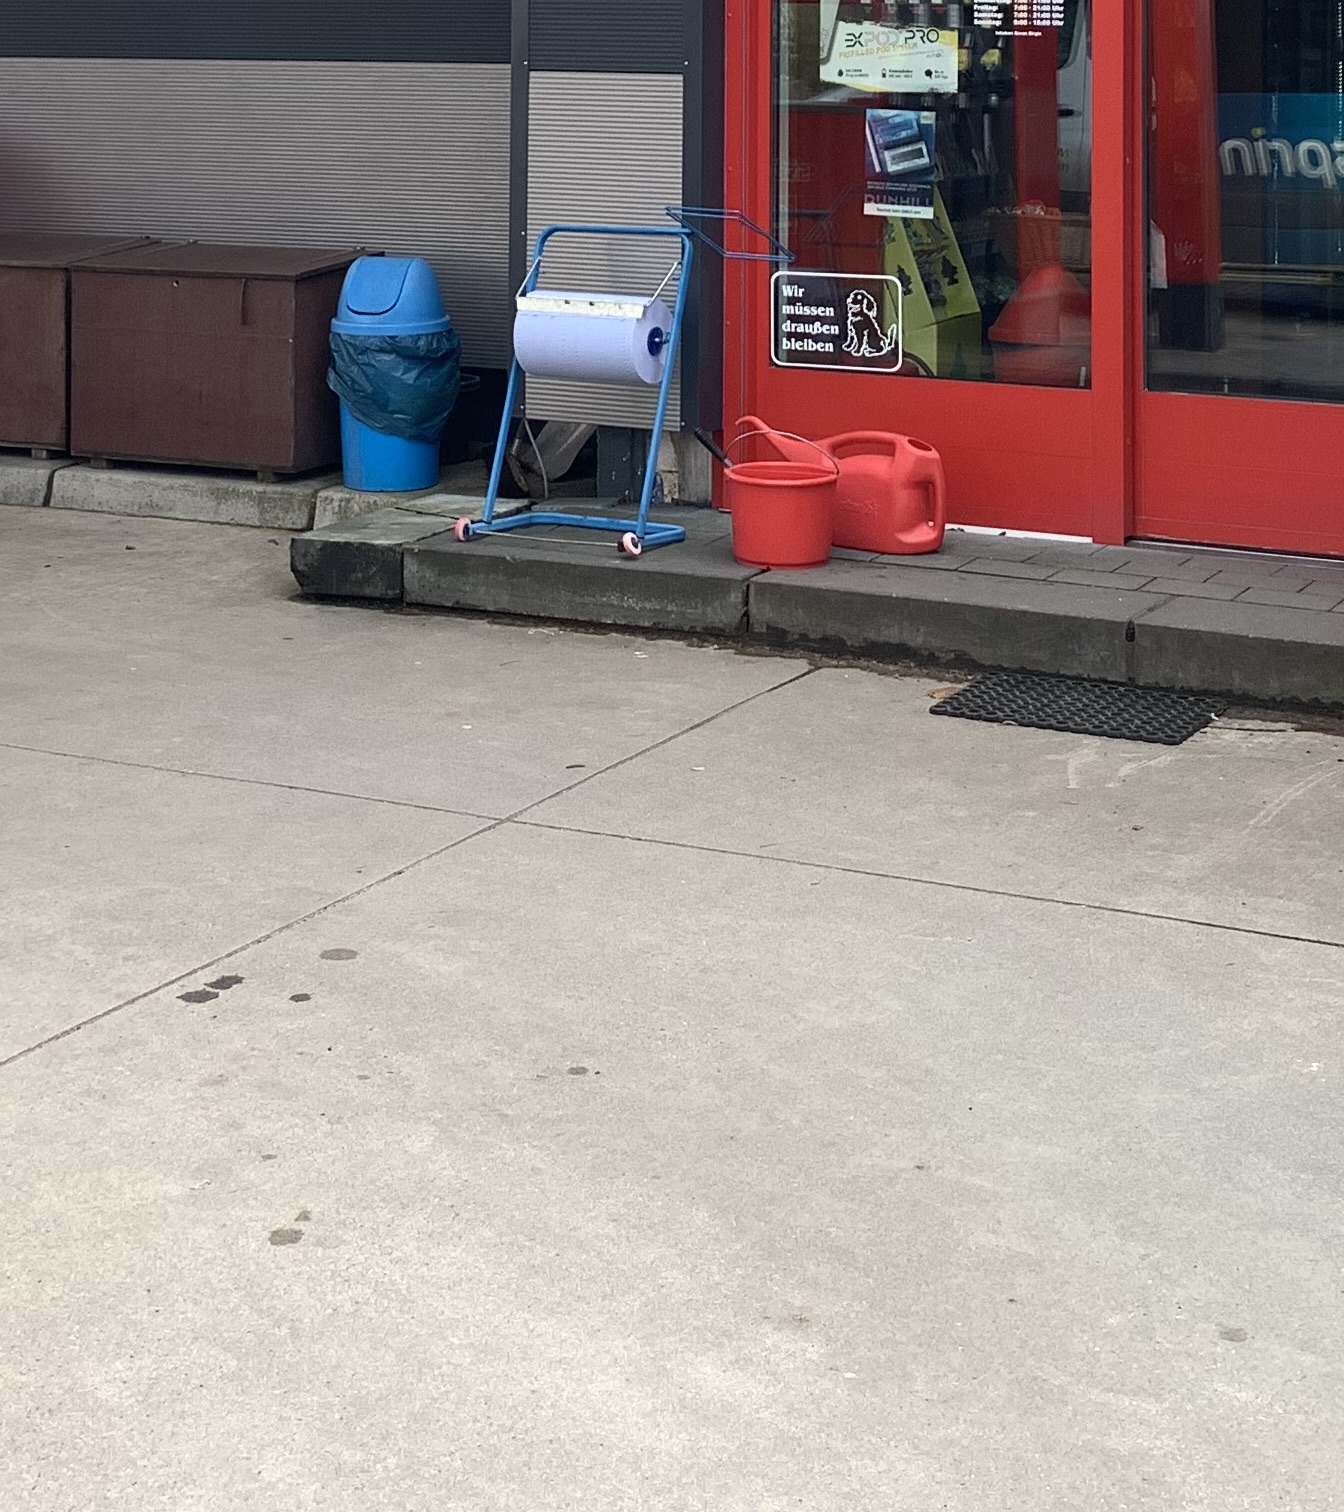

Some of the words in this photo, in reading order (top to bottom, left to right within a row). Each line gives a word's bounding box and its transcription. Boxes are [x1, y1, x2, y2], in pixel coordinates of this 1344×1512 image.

[904, 28, 940, 45] PRO
[781, 284, 806, 298] Wir
[781, 302, 835, 317] müssen
[781, 319, 840, 336] draußen
[781, 337, 835, 353] bleiben
